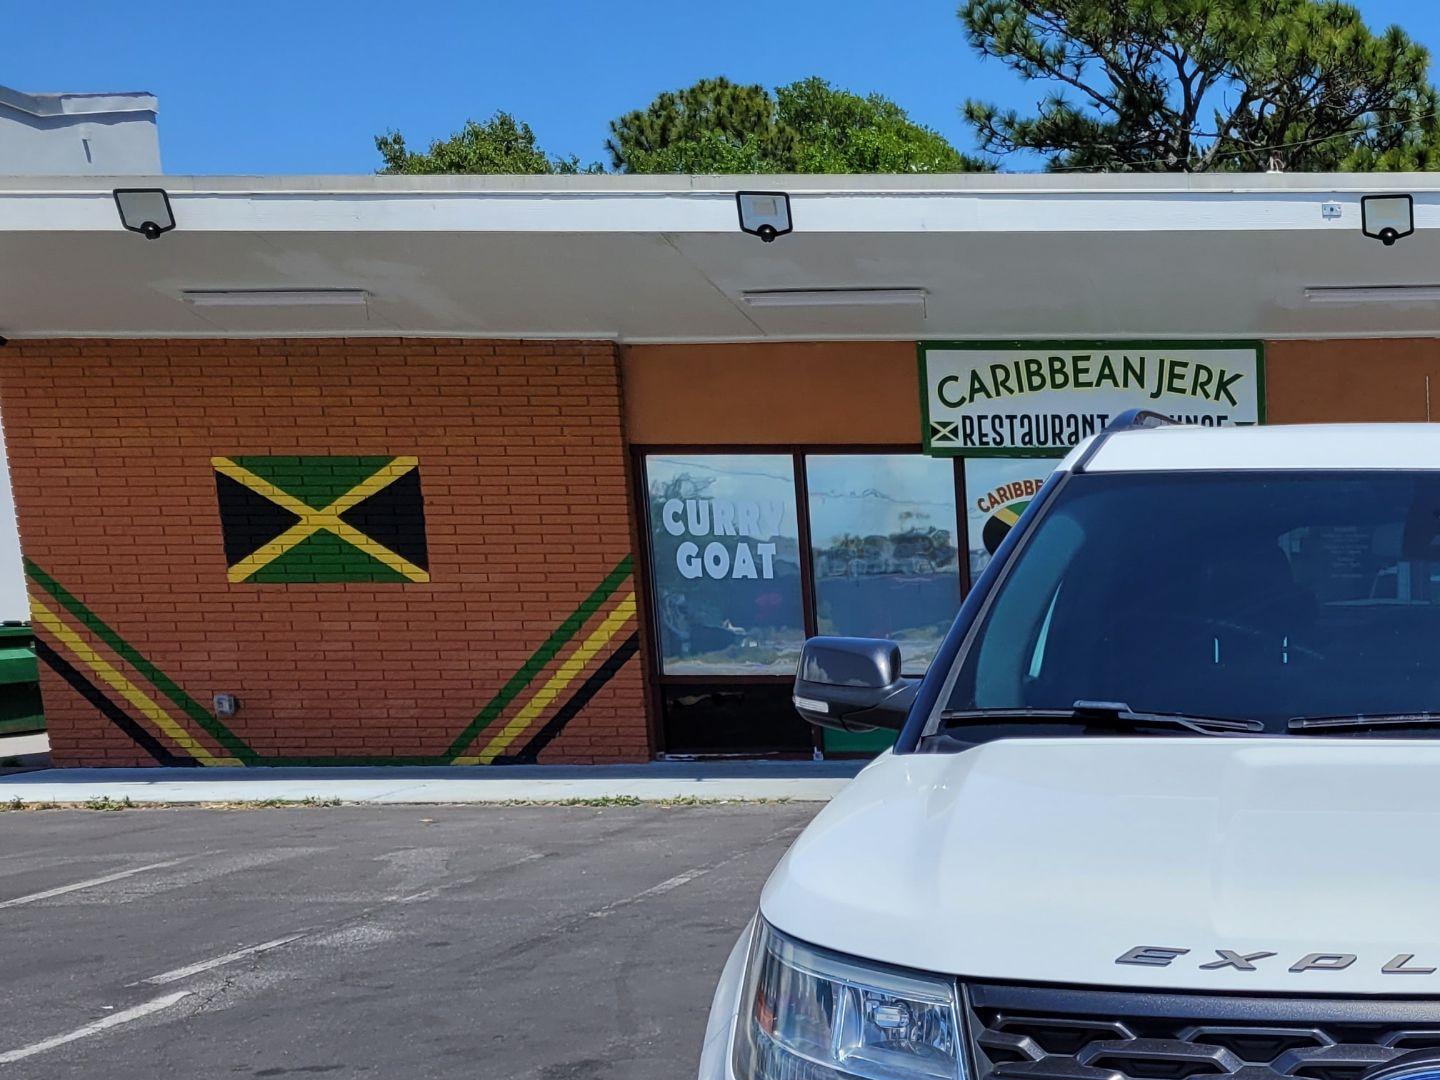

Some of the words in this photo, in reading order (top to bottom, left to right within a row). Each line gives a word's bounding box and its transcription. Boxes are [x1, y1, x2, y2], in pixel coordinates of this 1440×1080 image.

[936, 354, 1146, 409] CARIBBEAN
[1150, 358, 1245, 408] JERK
[662, 498, 785, 537] CURRY
[676, 541, 777, 580] GOAT
